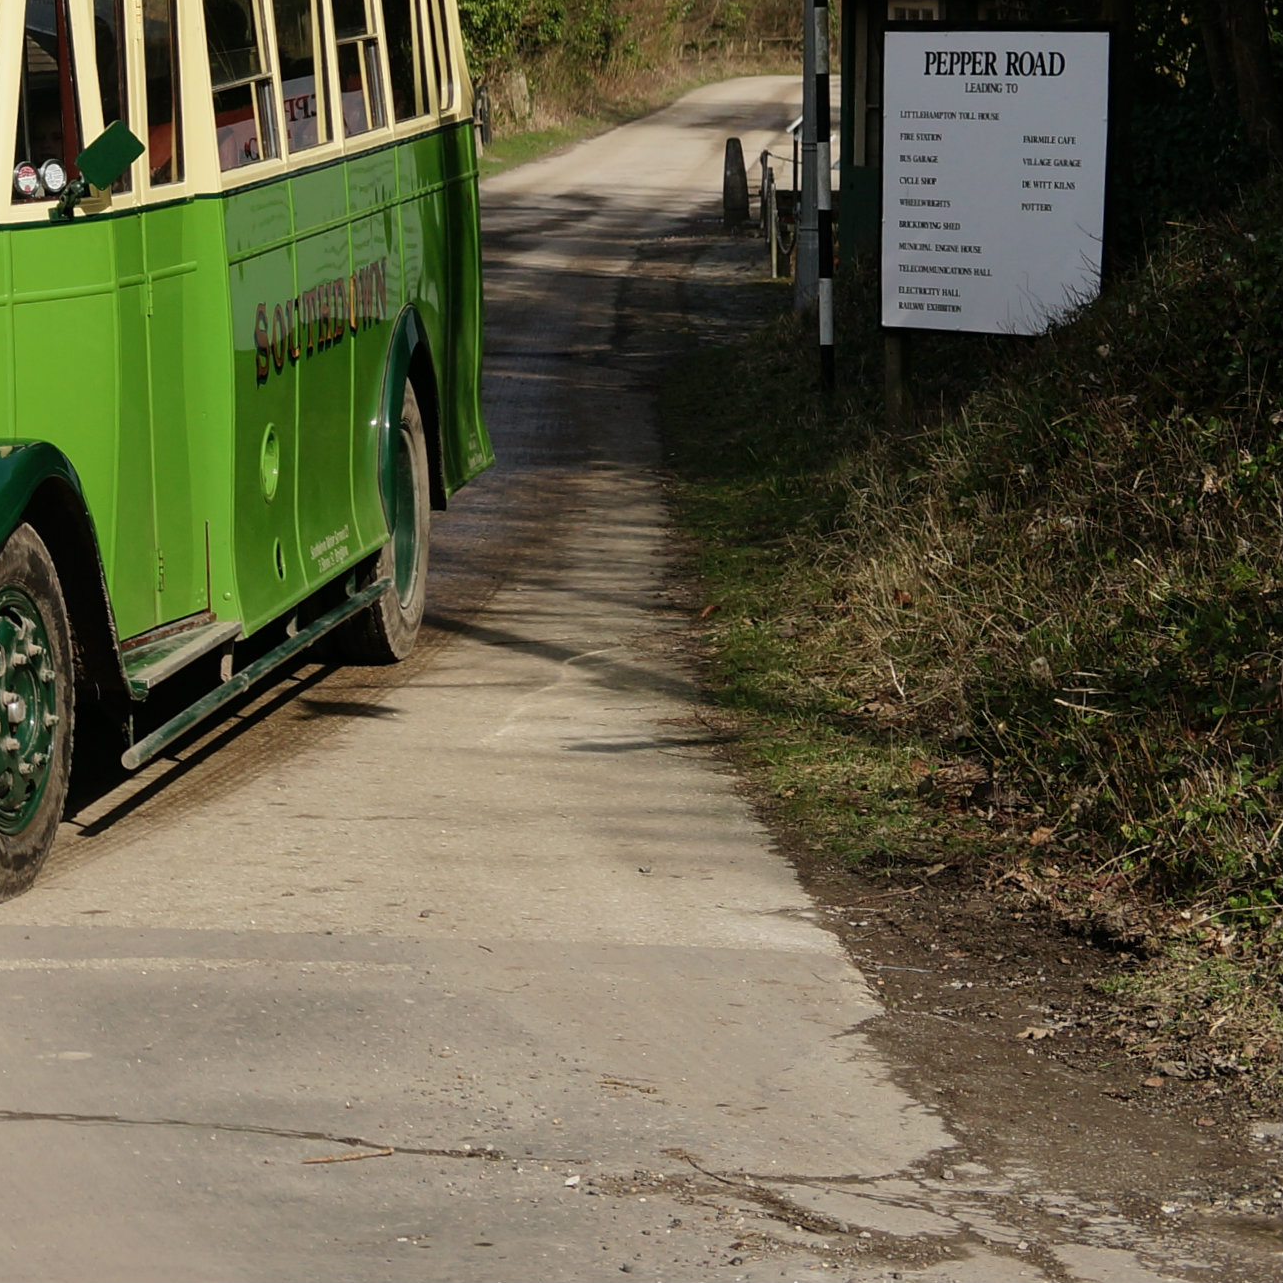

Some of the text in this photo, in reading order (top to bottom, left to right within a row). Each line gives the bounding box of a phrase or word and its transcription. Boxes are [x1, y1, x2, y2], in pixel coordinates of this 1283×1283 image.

[924, 50, 1066, 77] PEPPER ROAD
[965, 82, 1019, 94] LEADING TO
[900, 110, 1000, 121] LITTLEHAMPTON TOLL HOUSE
[900, 132, 943, 141] FIRE STATION
[1022, 135, 1077, 146] FAIRMILE CAFE
[899, 154, 939, 163] BUS GARAGE
[1022, 158, 1083, 168] VILLAGE GARAGE
[899, 176, 937, 186] CYCLE SHOP
[1022, 180, 1076, 190] DE WITT KILNS
[899, 198, 951, 208] WHEELWRIGHTS
[1021, 203, 1054, 212] POTTERY
[899, 220, 961, 231] BRICKDRYING SHED
[898, 242, 983, 254] MUNICIPAL ENGINE HOUSE
[898, 264, 993, 277] TELECOMMUNICATIONS HALL
[898, 285, 961, 297] ELECTRICITY HALL
[898, 301, 963, 313] RAILWAY EXHIBITION
[254, 259, 388, 388] SOUTHDOWN
